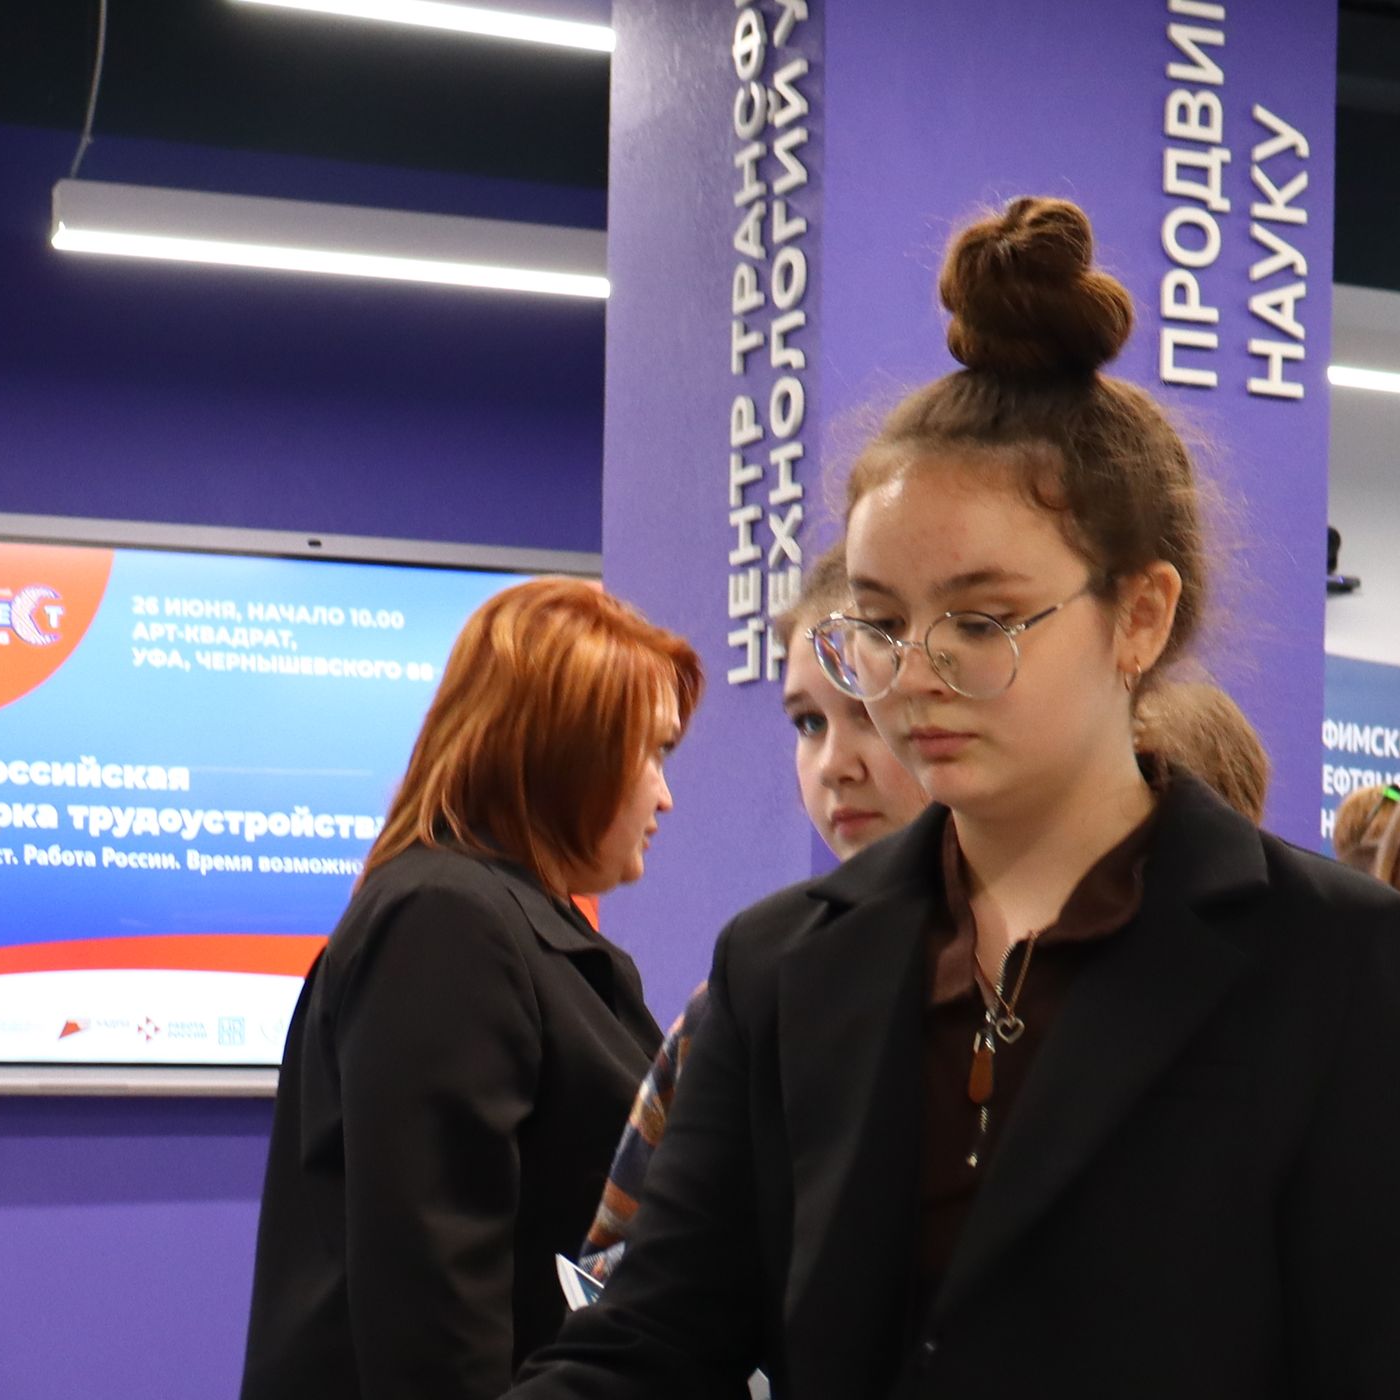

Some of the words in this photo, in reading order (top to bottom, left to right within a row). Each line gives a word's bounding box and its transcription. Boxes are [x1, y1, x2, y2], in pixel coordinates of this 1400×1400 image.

[732, 0, 768, 376] ТРАНСФ
[1247, 103, 1311, 401] НАУКУ
[727, 395, 765, 685] ЦЕНТР
[165, 596, 242, 622] ИЮНЯ,
[248, 602, 345, 626] НАЧАЛО
[350, 608, 405, 630] 10.00
[131, 621, 297, 651] АРТ-КВАДРАТ,
[131, 646, 191, 673] УФА,
[195, 651, 402, 681] ЧЕРНЫШЕВСКОГО
[24, 844, 96, 868] Работа
[102, 847, 180, 870] России.
[187, 850, 254, 877] Время
